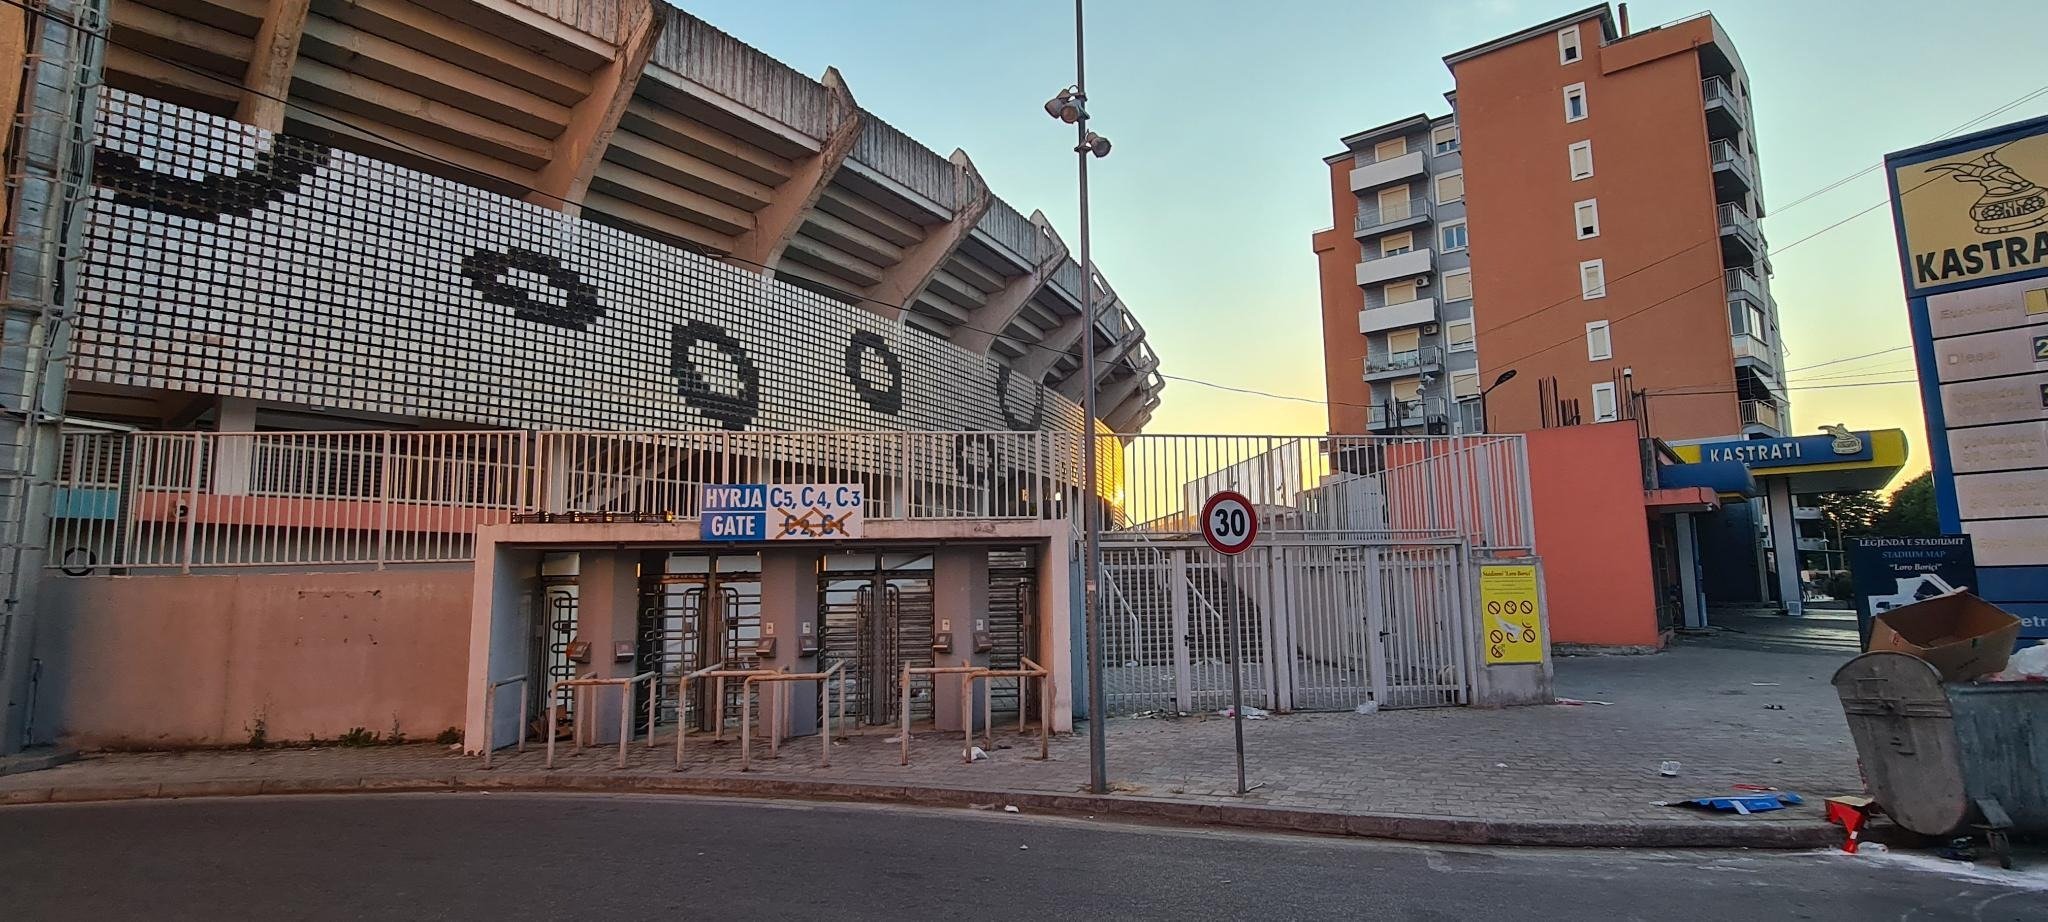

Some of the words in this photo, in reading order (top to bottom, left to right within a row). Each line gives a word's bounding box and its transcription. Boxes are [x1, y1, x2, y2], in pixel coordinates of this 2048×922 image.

[1915, 231, 2048, 282] KASTRA
[1710, 442, 1801, 462] KASTRATI
[705, 488, 763, 508] HYRJA
[836, 486, 861, 507] C3
[711, 515, 756, 536] GATE
[1215, 508, 1245, 537] 30
[1859, 539, 1905, 547] LEGJENDA
[1914, 537, 1965, 546] STADIUMIT
[1881, 551, 1923, 560] STADIUM
[1925, 550, 1946, 560] MAP
